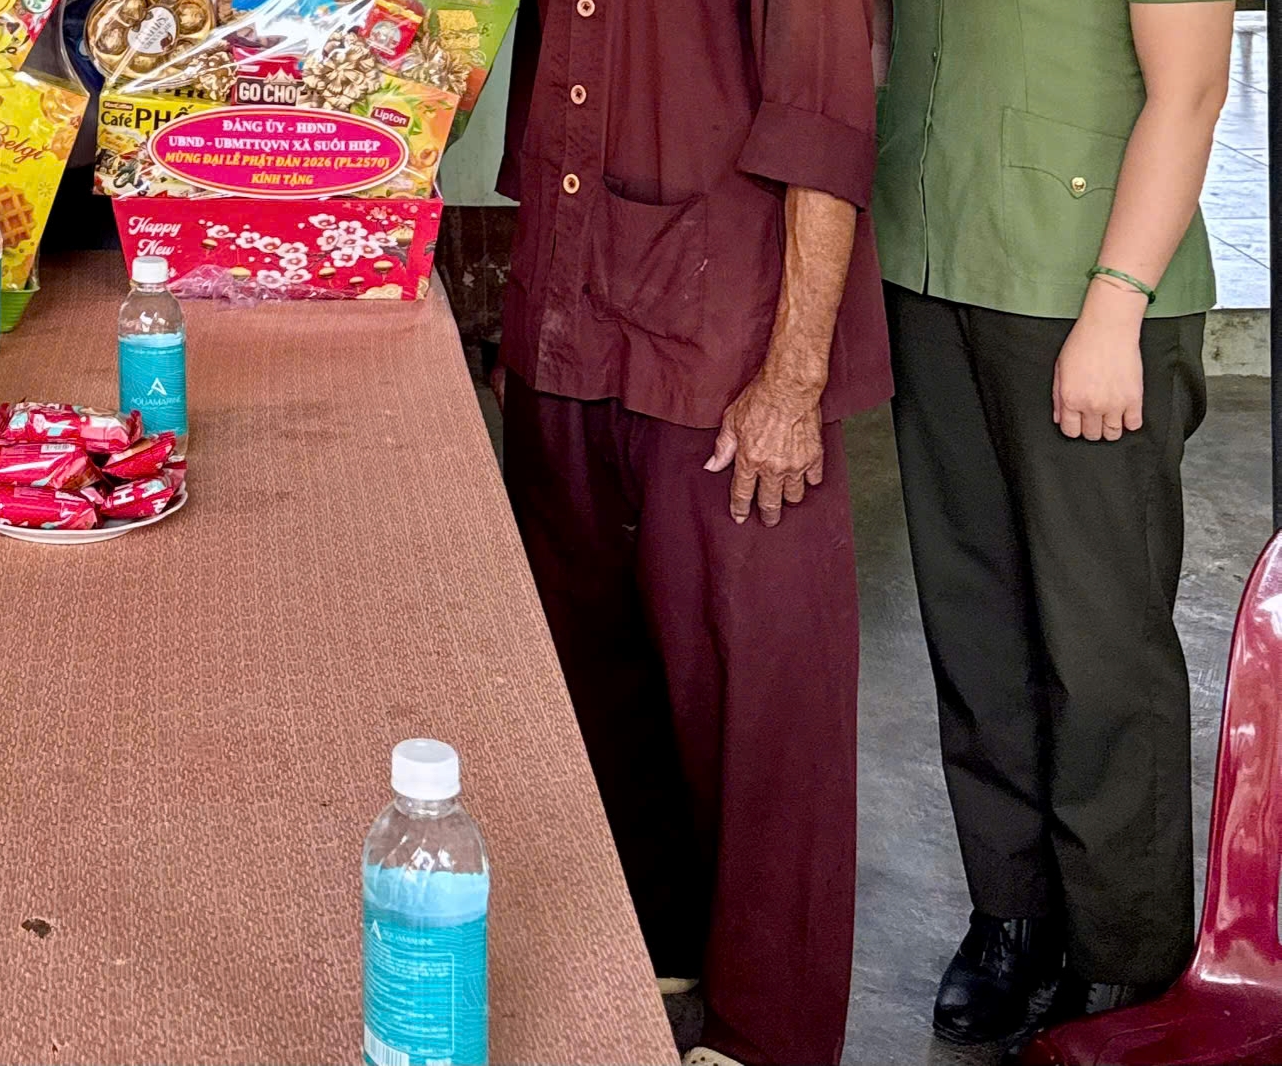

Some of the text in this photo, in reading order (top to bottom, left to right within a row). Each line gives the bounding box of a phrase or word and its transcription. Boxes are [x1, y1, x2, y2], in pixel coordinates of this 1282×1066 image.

[239, 82, 261, 102] GO
[101, 111, 132, 127] Café
[374, 108, 407, 125] Lipton
[222, 118, 263, 133] ĐẢNG
[265, 118, 286, 133] ỦY
[295, 122, 337, 134] HĐND
[168, 135, 205, 148] UBND
[214, 137, 290, 152] UBMTTQVN
[292, 138, 311, 151] XÃ
[313, 138, 347, 151] SUỐI
[348, 138, 381, 153] HIỆP
[165, 150, 201, 163] MỪNG
[202, 153, 225, 166] ĐẠI
[225, 151, 241, 165] LỄ
[242, 153, 275, 168] PHẬT
[302, 156, 332, 167] 2026
[251, 171, 314, 187] KÍNH TẶNG
[128, 216, 182, 237] Happy
[137, 238, 175, 256] New
